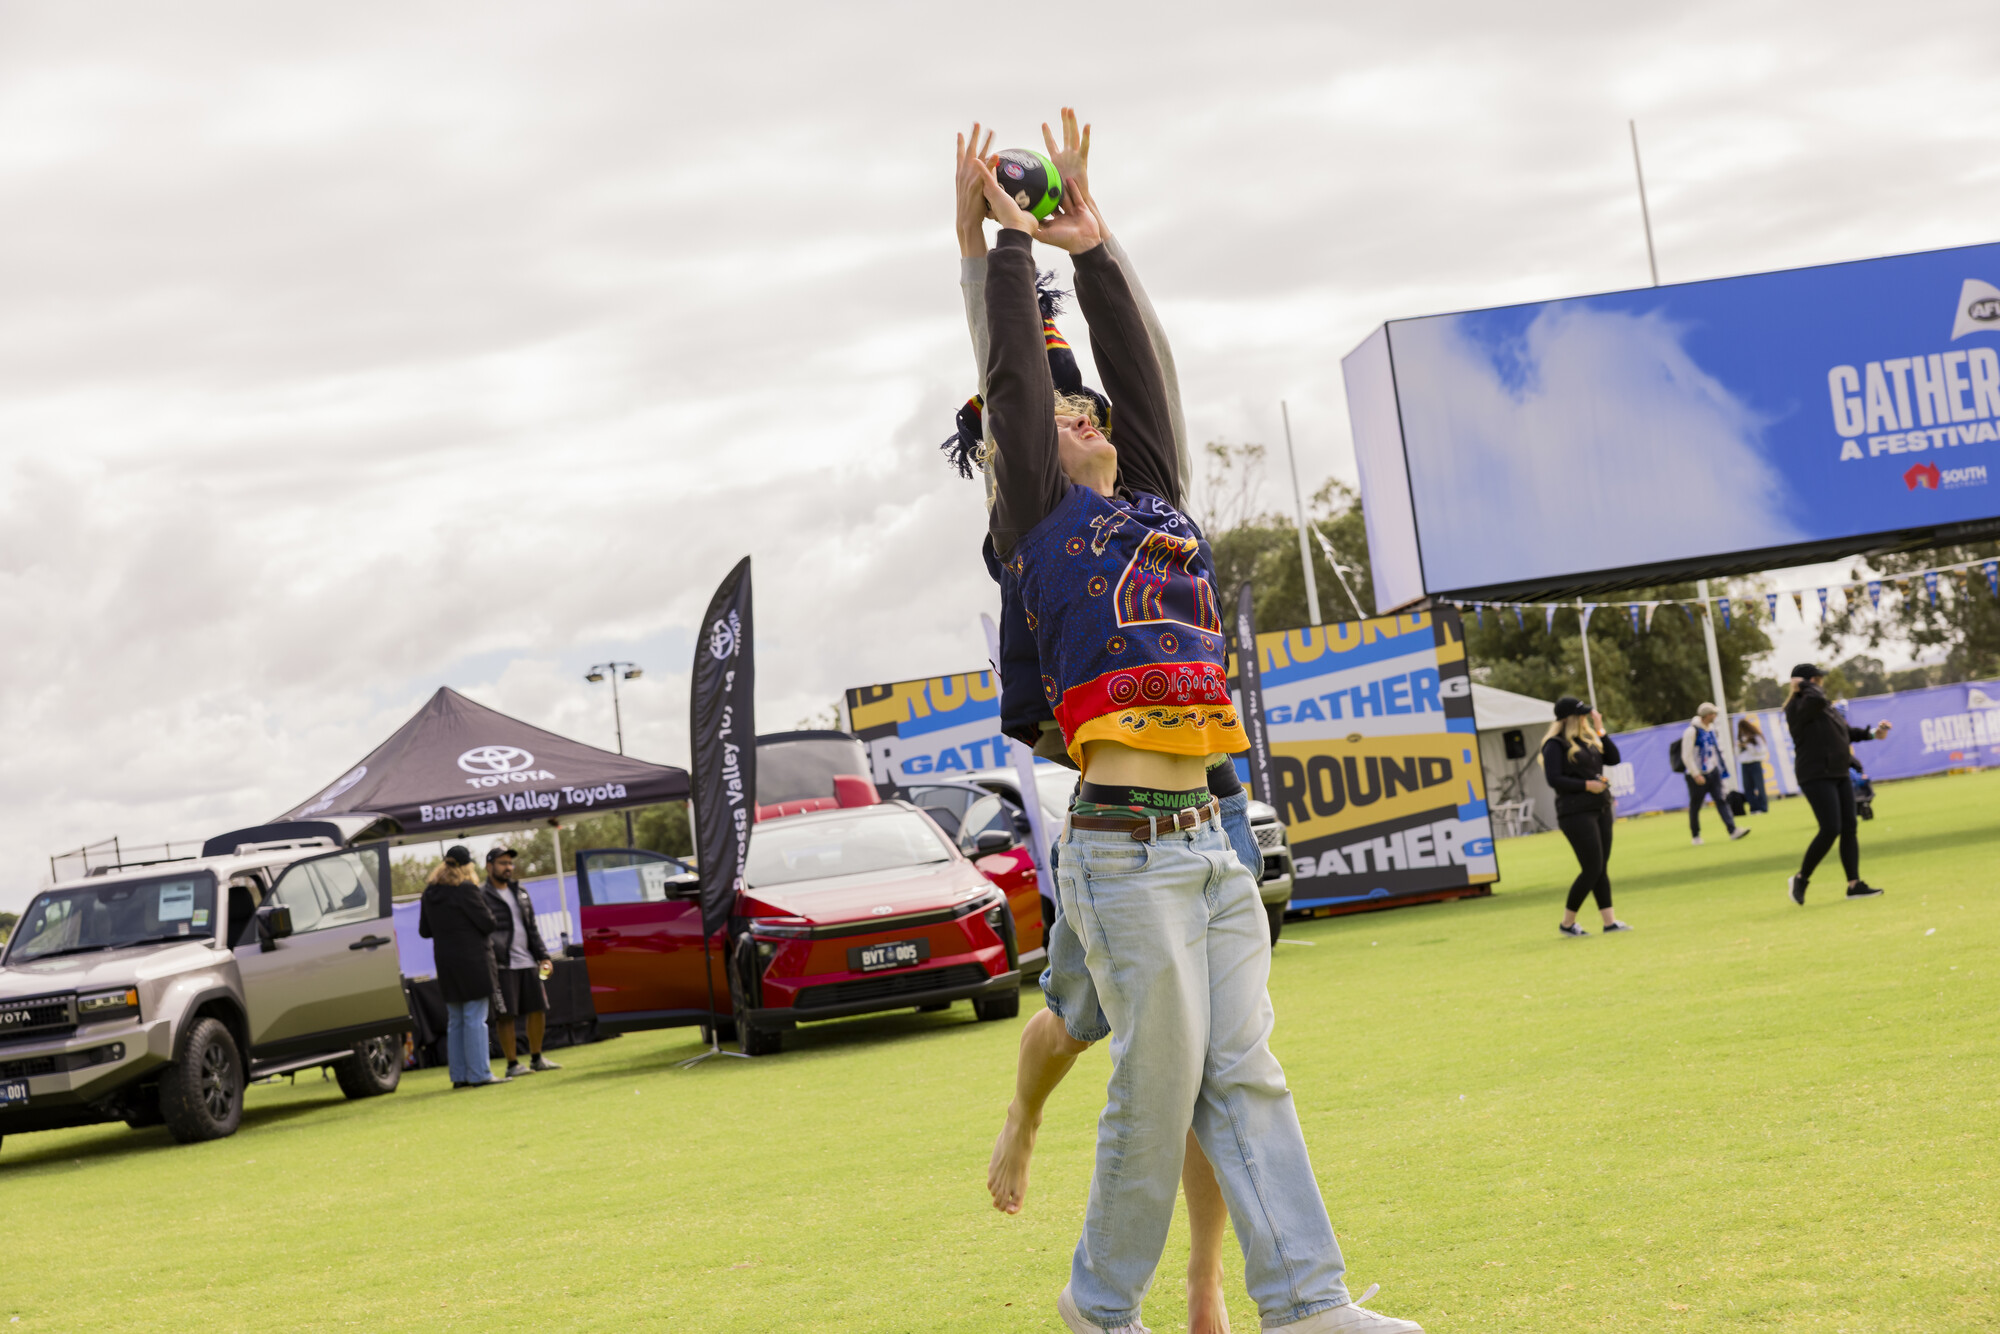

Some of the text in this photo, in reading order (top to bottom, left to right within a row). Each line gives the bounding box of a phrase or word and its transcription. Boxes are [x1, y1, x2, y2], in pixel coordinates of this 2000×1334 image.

[1828, 347, 2000, 438] GATHER
[1840, 440, 1864, 461] A
[1941, 465, 1987, 484] SOUTH
[1265, 667, 1444, 725] GATHER
[466, 769, 556, 789] TOYOTA
[721, 742, 745, 807] Valley
[419, 782, 627, 823] Barossa Valley Toyota
[1153, 792, 1196, 808] SWAG
[1270, 755, 1453, 826] ROUND
[1294, 818, 1467, 880] GATHER
[862, 949, 885, 966] BVT
[896, 944, 917, 960] 005
[7, 1084, 27, 1100] 001
